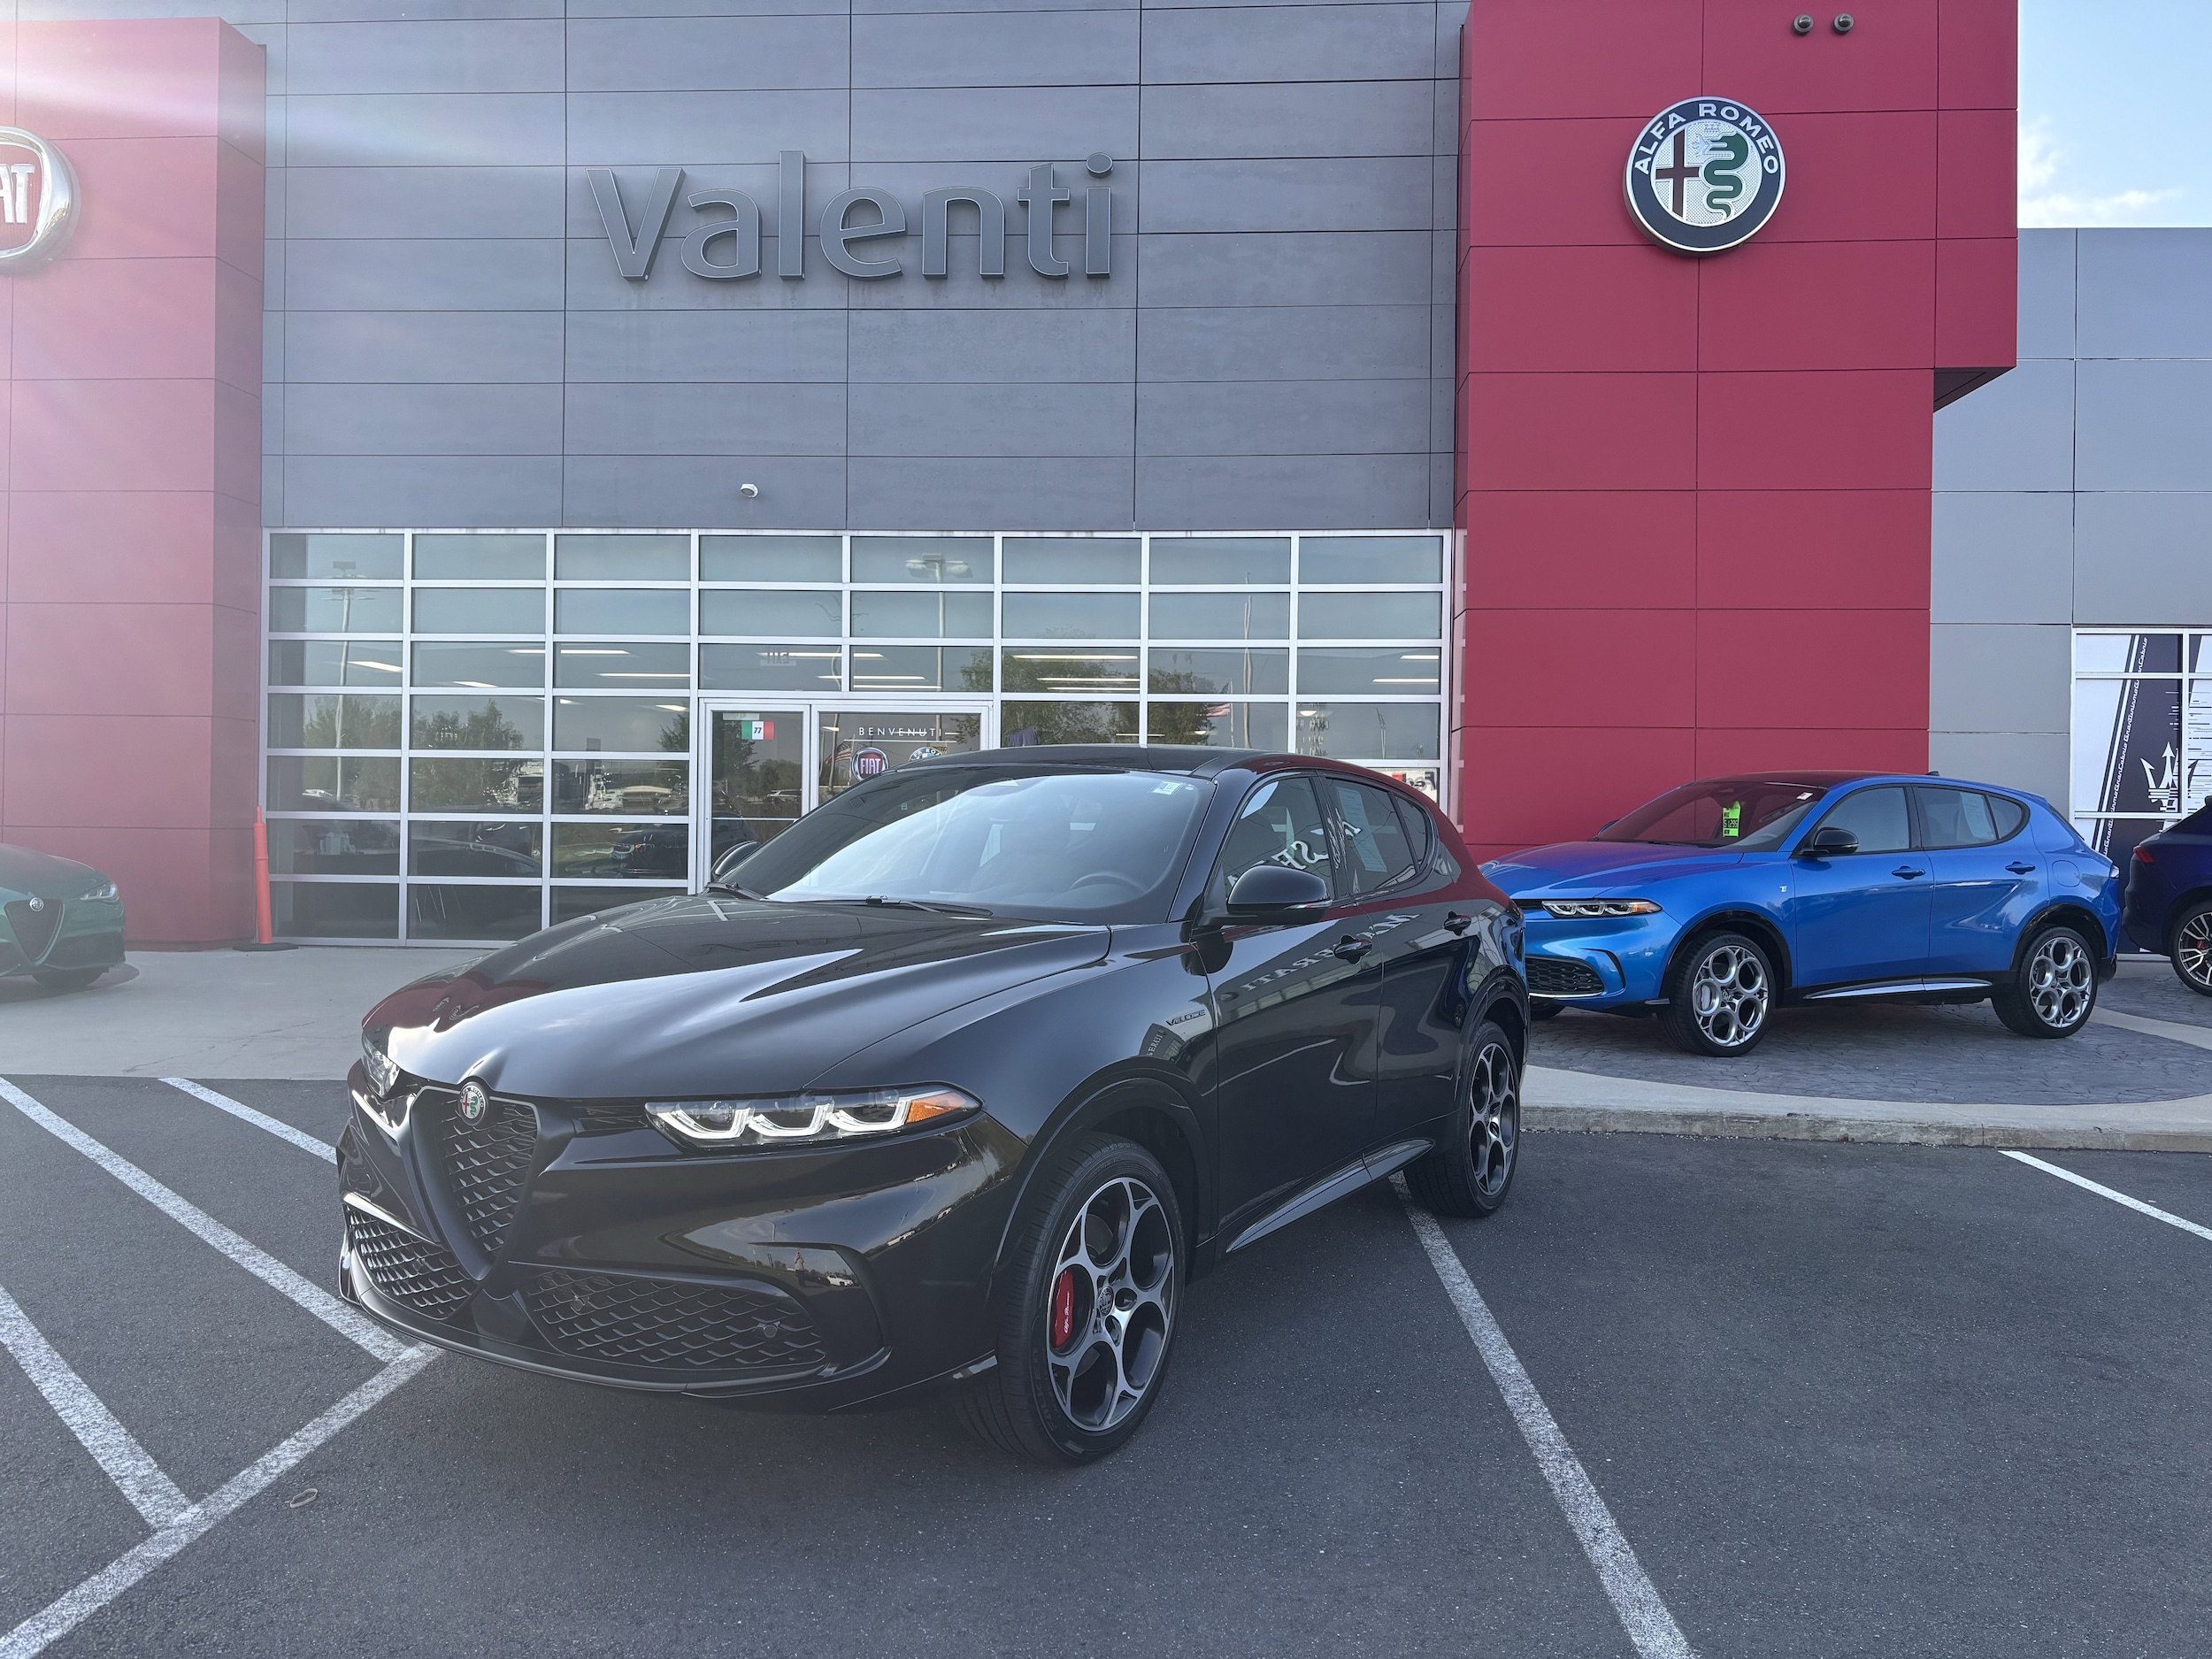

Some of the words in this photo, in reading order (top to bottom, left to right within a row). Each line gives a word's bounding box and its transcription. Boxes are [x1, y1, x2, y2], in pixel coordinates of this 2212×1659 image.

[1634, 112, 1686, 175] ALFA
[1698, 103, 1779, 175] ROMEO
[585, 150, 1114, 280] Valenti
[858, 727, 942, 737] BENVENUTI
[860, 758, 881, 775] FIAT
